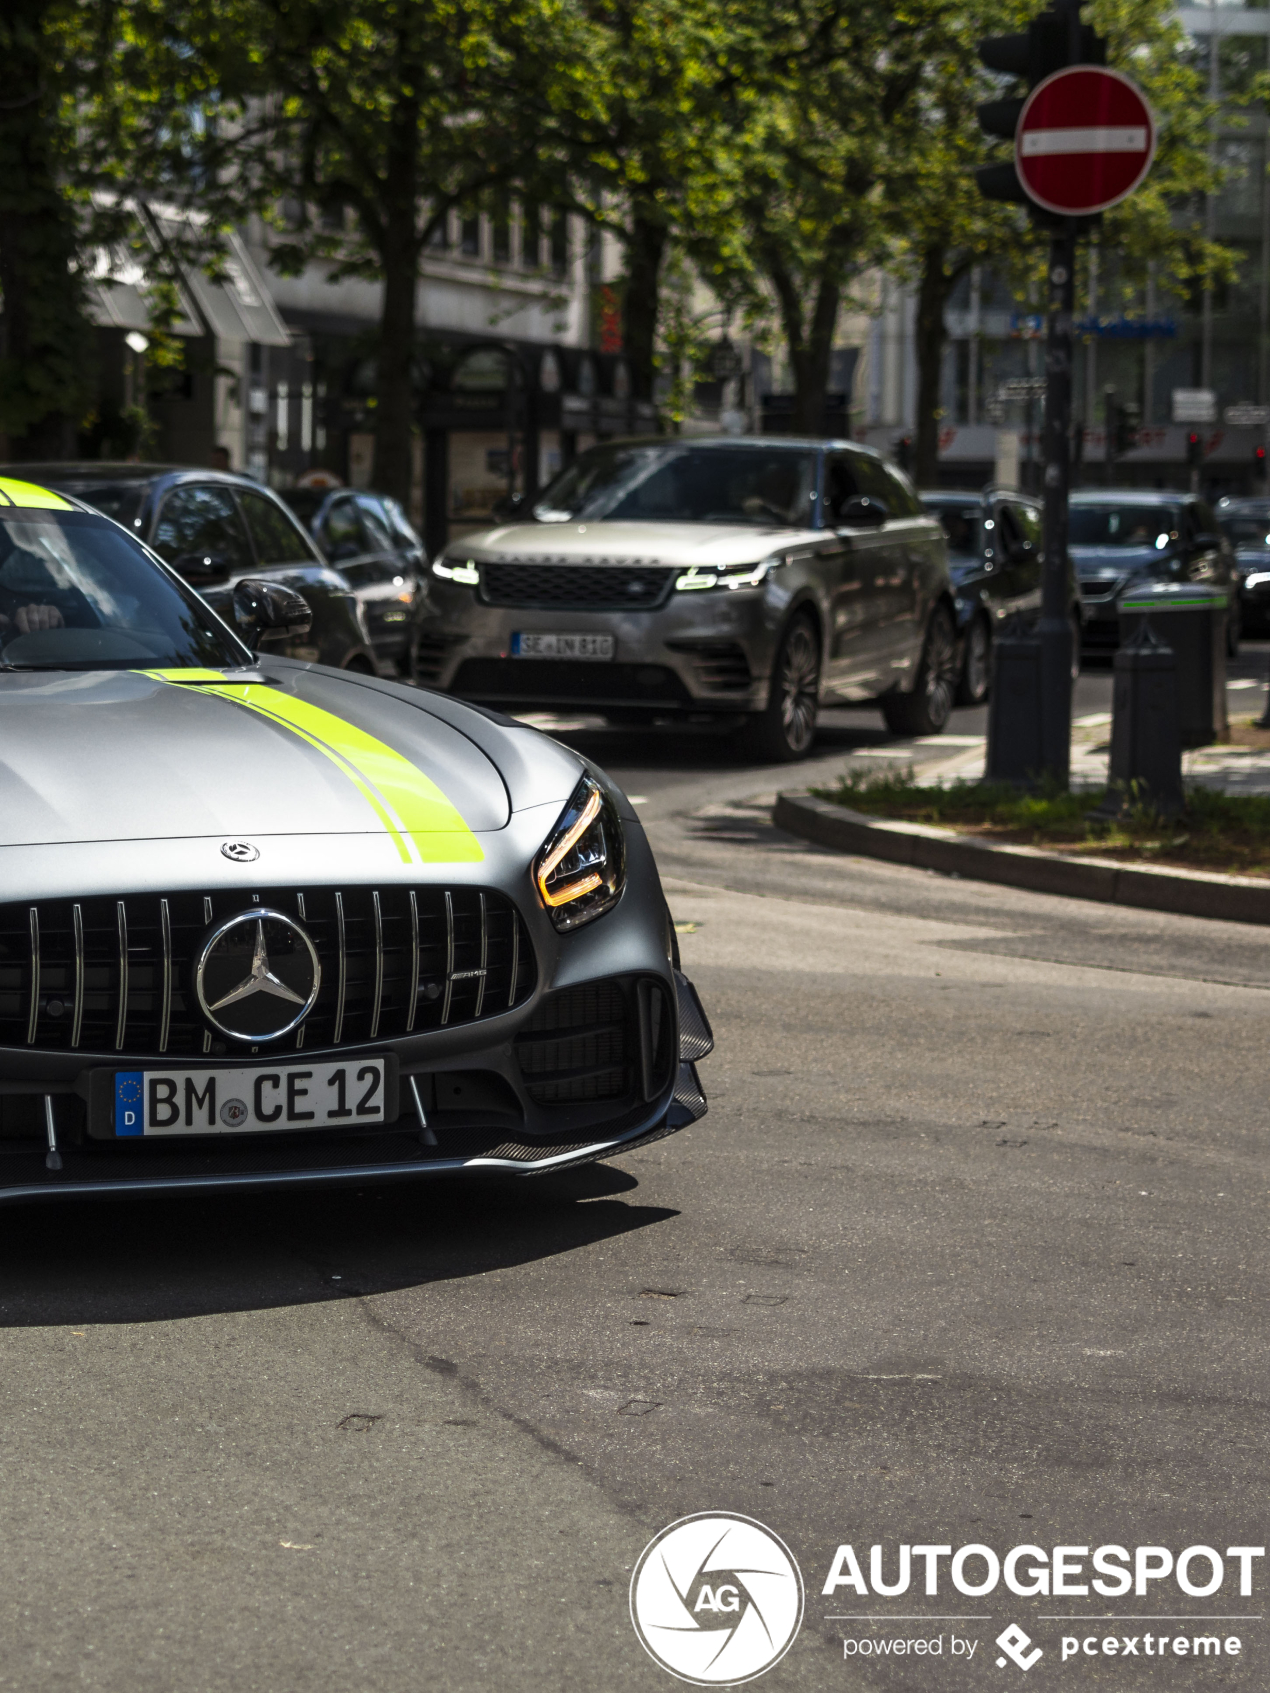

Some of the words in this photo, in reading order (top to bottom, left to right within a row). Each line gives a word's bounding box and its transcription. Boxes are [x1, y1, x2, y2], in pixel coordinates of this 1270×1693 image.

[148, 1076, 217, 1128] BM
[253, 1071, 315, 1123] CE
[327, 1065, 382, 1119] 12
[124, 1111, 136, 1126] D
